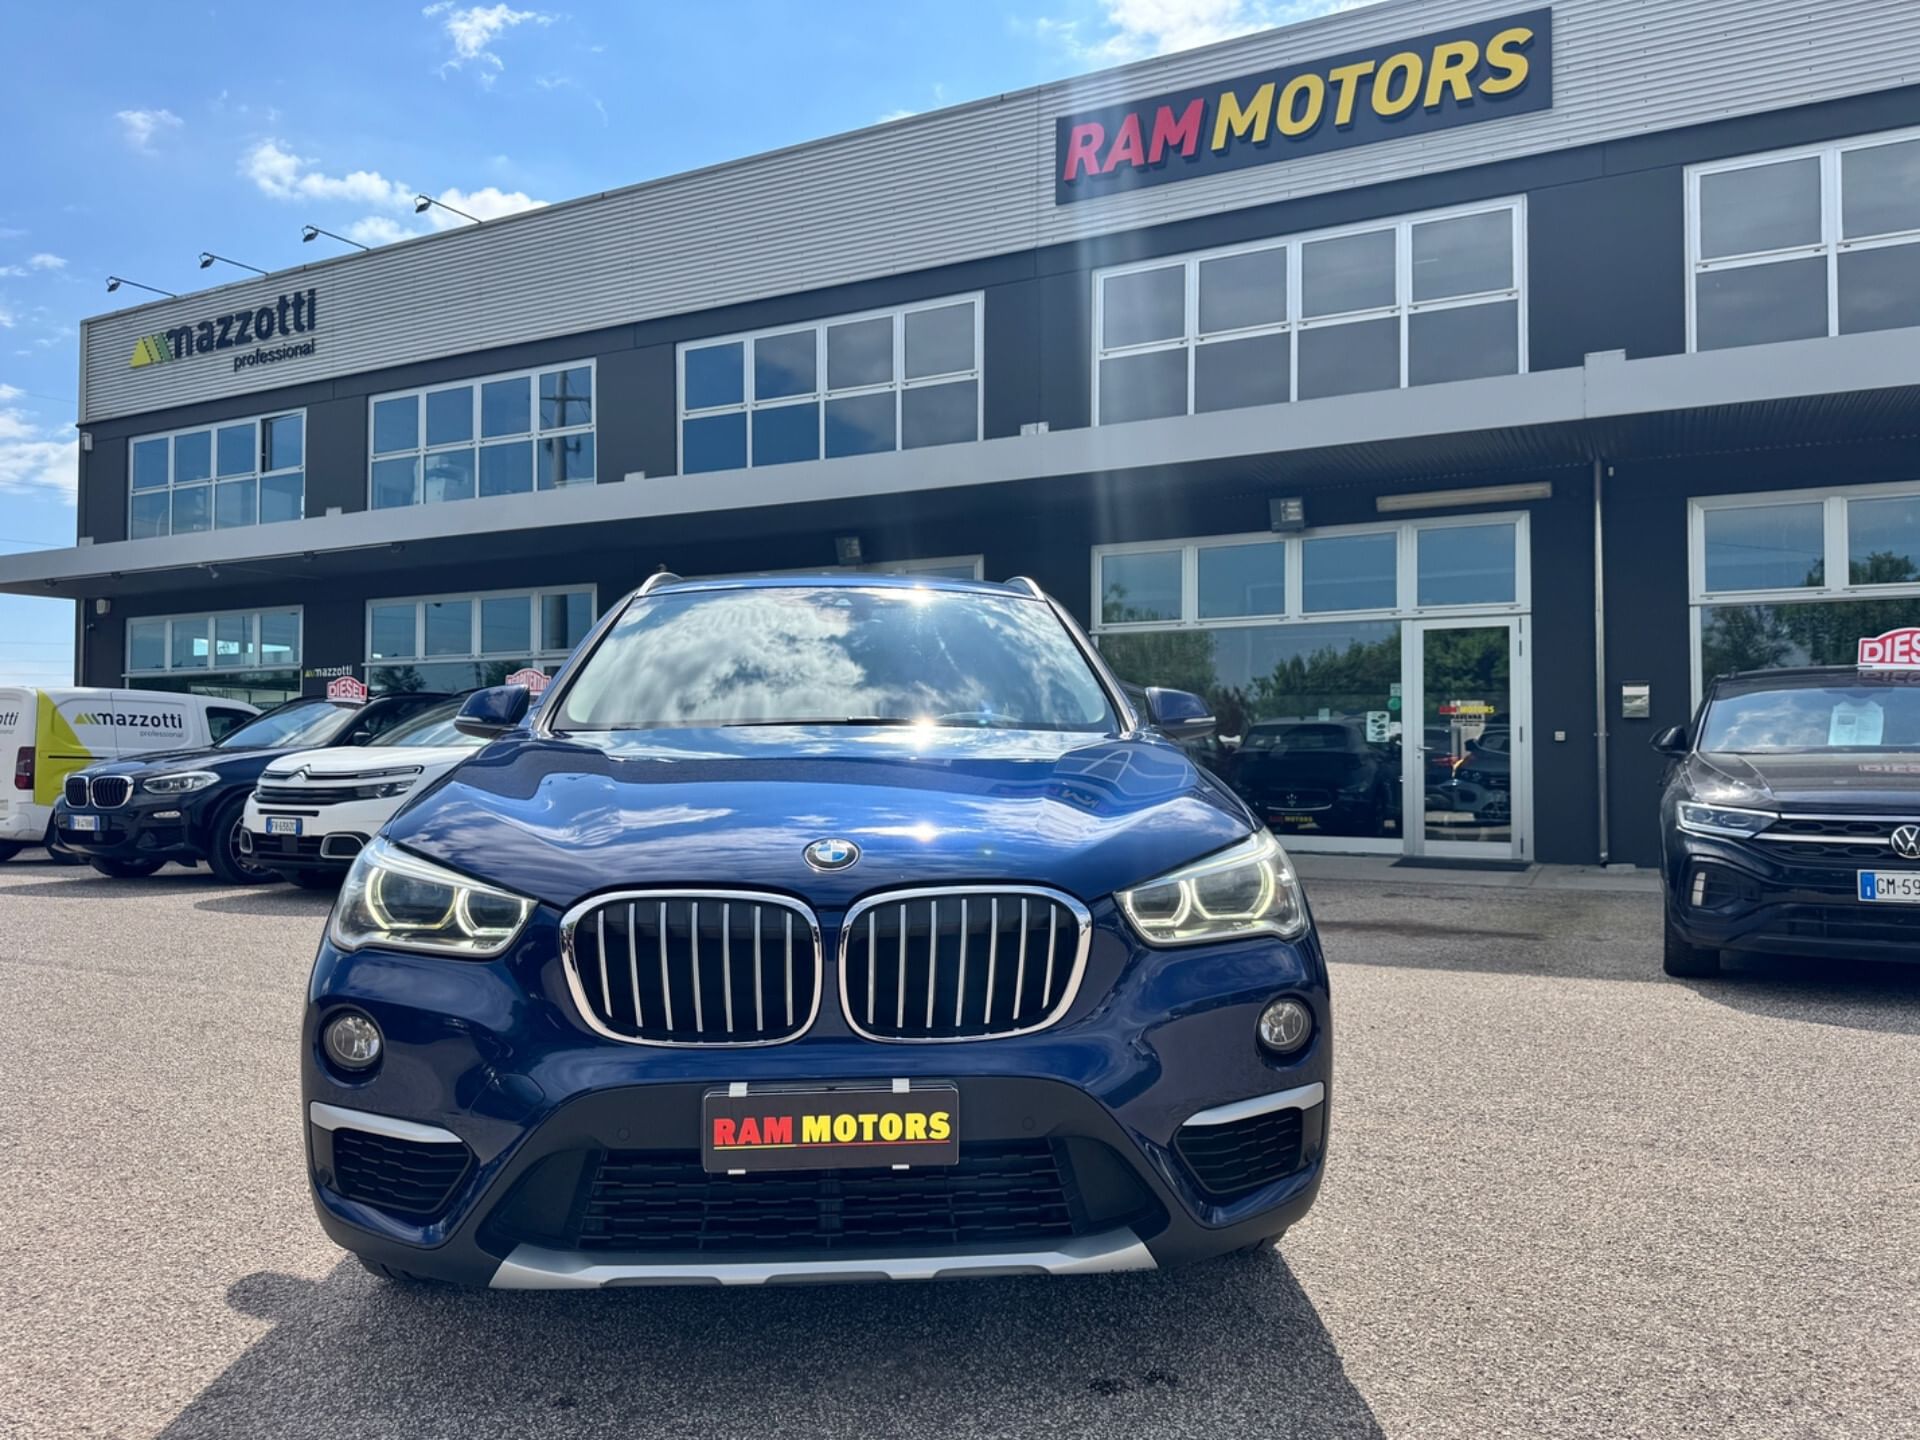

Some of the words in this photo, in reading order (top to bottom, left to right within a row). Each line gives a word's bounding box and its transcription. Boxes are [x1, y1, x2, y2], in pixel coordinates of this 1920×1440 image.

[1063, 98, 1204, 182] RAM
[1211, 27, 1534, 151] MOTORS
[166, 288, 316, 359] mazzotti
[234, 338, 316, 373] professional
[314, 664, 353, 677] mazzotti
[329, 680, 366, 698] DIESEL
[97, 713, 183, 729] mazzotti
[713, 1116, 793, 1146] RAM
[802, 1111, 951, 1143] MOTORS
